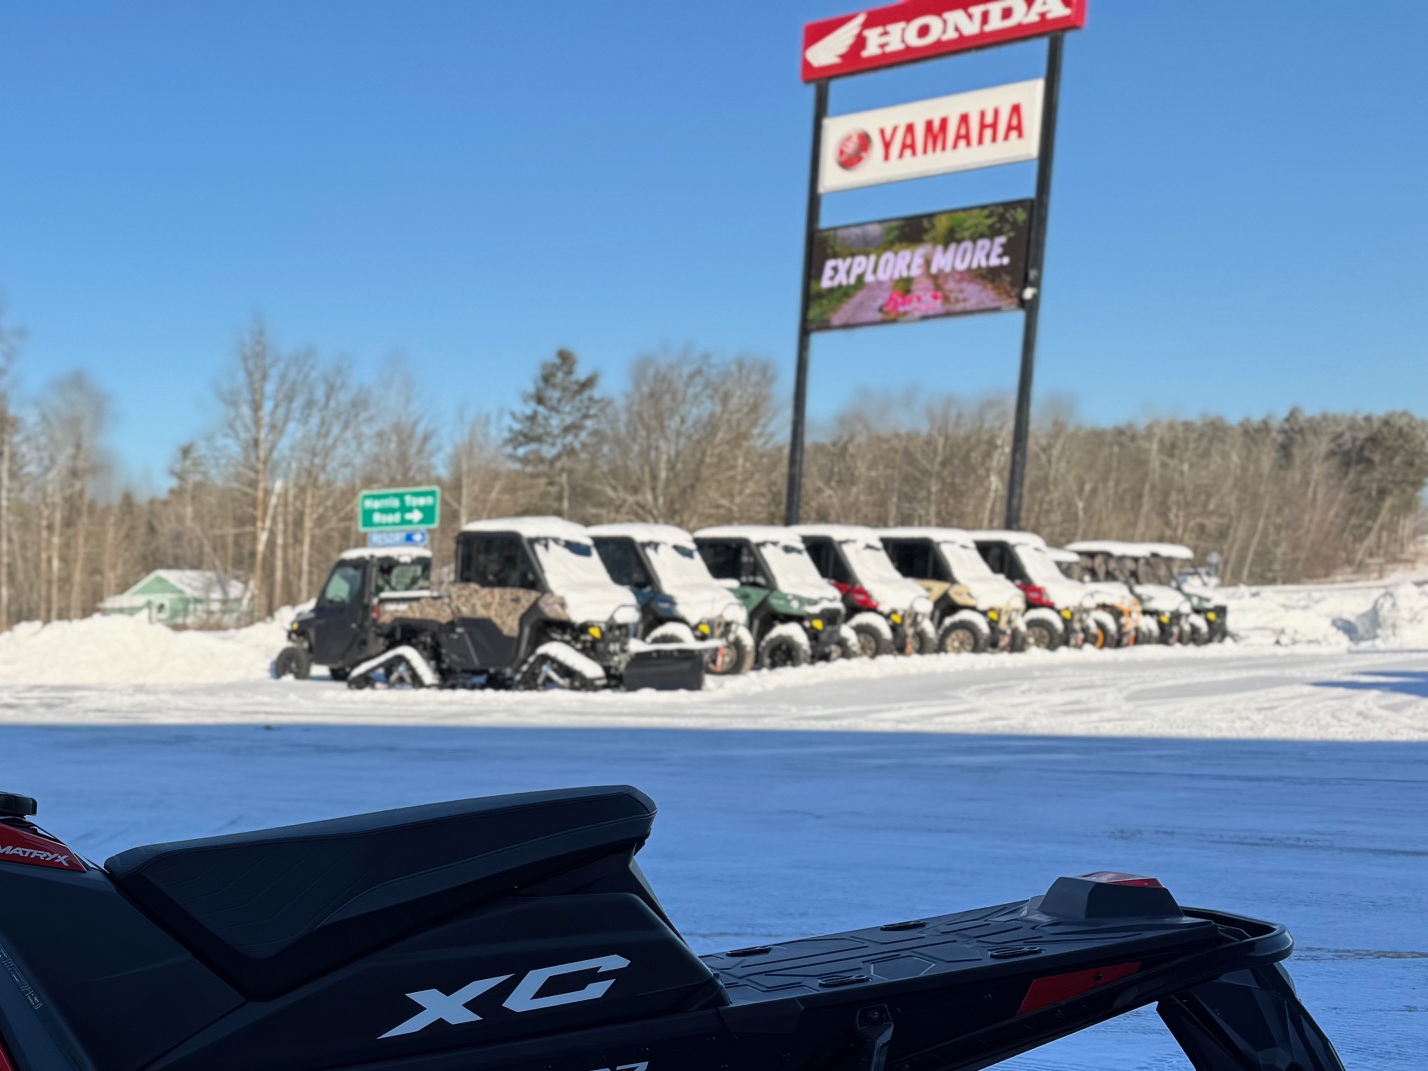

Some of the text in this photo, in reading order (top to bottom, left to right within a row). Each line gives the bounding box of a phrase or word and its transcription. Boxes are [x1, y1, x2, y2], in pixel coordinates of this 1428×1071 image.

[860, 0, 1072, 58] HONDA
[879, 102, 1025, 162] YAMAHA
[820, 235, 1010, 289] EXPLORE MORE.
[376, 954, 632, 1039] XC
